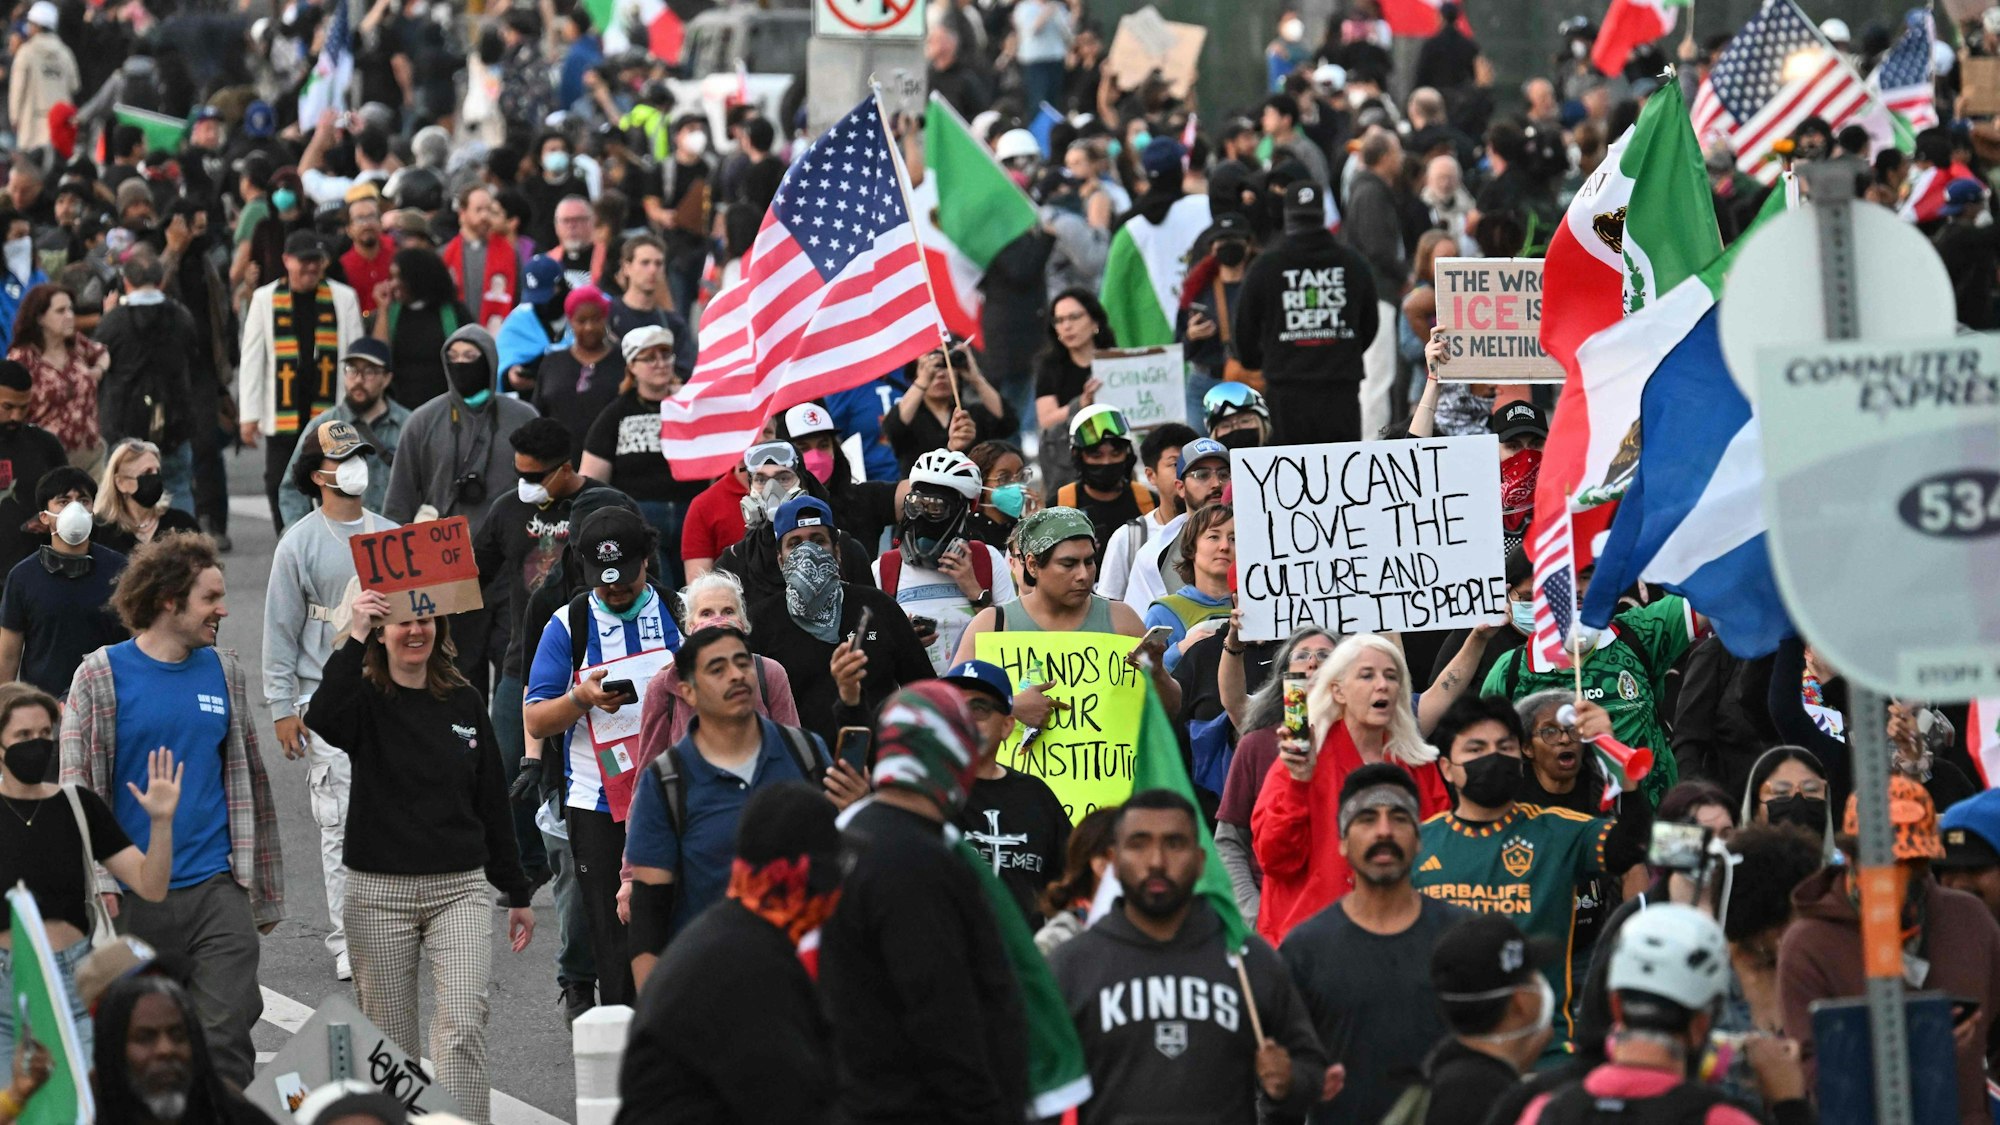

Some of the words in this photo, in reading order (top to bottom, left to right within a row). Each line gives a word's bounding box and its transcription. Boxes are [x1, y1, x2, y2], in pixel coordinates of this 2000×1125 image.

[1282, 267, 1345, 289] TAKE
[1445, 270, 1489, 292] THE
[1498, 269, 1543, 292] WR
[1286, 308, 1346, 330] DEPT.
[1453, 295, 1519, 330] ICE
[1785, 350, 1979, 386] COMMUTER
[1242, 455, 1329, 513] YOU
[1341, 443, 1447, 505] CAN'T
[1268, 503, 1368, 560] LOVE
[1382, 493, 1468, 547] THE
[361, 531, 421, 584] ICE
[430, 522, 461, 542] OUT
[442, 548, 461, 565] OF
[1246, 557, 1369, 600] CULTURE
[1380, 553, 1439, 590] AND
[409, 590, 436, 616] LA
[1275, 594, 1359, 638] HATE
[1432, 577, 1504, 623] PEOPLE
[963, 663, 978, 678] LA
[1100, 974, 1240, 1033] KINGS
